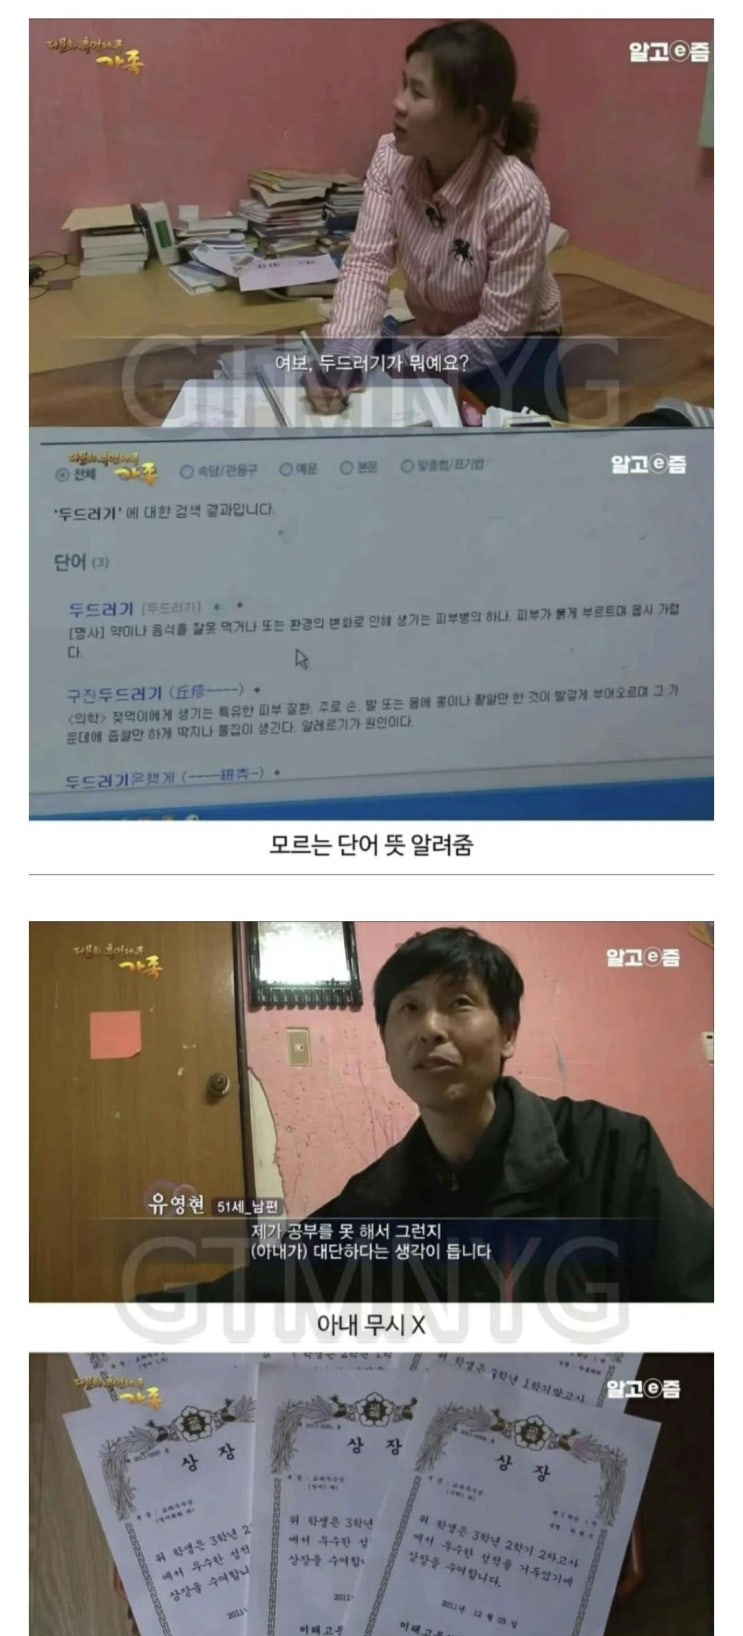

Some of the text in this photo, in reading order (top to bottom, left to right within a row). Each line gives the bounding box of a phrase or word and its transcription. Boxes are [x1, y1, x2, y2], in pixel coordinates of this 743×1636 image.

[126, 507, 139, 520] 에
[144, 505, 171, 519] 대한
[176, 504, 201, 519] 검색
[54, 553, 87, 572] 단어
[69, 602, 134, 618] 두드러기
[221, 621, 257, 634] 먹거나
[262, 619, 285, 633] 또는
[495, 1454, 550, 1482] 상 장
